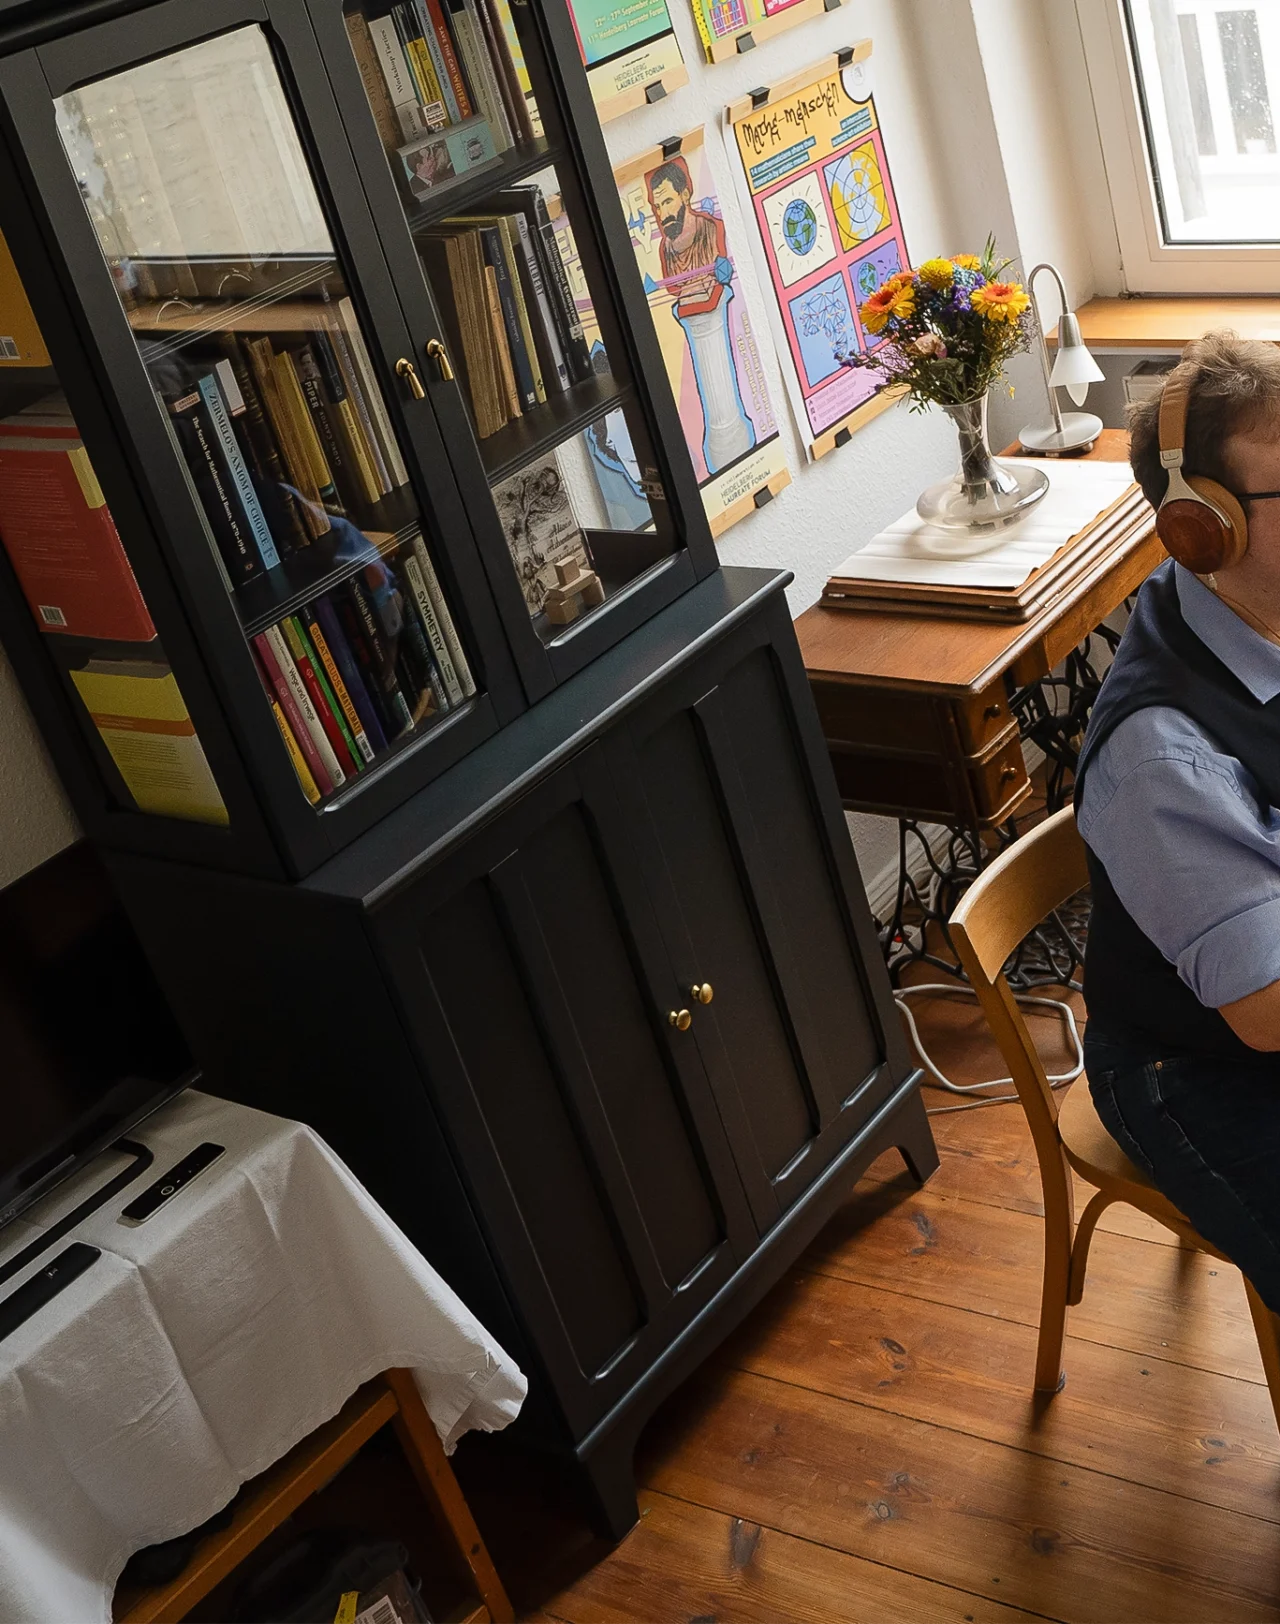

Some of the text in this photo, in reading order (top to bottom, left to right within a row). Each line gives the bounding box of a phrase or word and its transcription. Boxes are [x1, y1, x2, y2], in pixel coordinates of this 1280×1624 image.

[380, 29, 403, 94] Workshop Tactics
[420, 6, 433, 36] CREATING
[429, 37, 444, 74] CHARACTER
[438, 25, 447, 43] SAVE
[444, 44, 452, 57] THE
[448, 58, 457, 74] CAT!
[453, 74, 467, 107] WRITES
[613, 62, 647, 82] HEIDELBERG
[616, 64, 665, 91] LAUREATE FORUM
[518, 220, 544, 297] REID HILBERT
[548, 236, 569, 284] Mathematical
[741, 312, 753, 337] Forum
[304, 381, 319, 408] PIPER
[755, 372, 774, 415] Heidelberg
[192, 416, 200, 429] The
[197, 429, 208, 451] Search
[204, 450, 212, 460] for
[209, 460, 227, 502] Mathematical
[223, 501, 232, 521] Roots,
[209, 392, 236, 453] ZERMELO'S
[231, 456, 249, 491] AXIOM
[244, 491, 256, 505] OF
[250, 507, 269, 546] CHOICE
[720, 472, 754, 499] HEIDELBERG
[723, 469, 771, 506] LAUREATE FORUM
[354, 583, 368, 615] Scottish
[364, 613, 377, 636] Book
[416, 590, 445, 651] SYMMETRY
[312, 627, 329, 657] GREAT
[325, 657, 342, 688] FEUDS
[288, 667, 300, 687] Wege
[296, 686, 306, 700] und
[302, 697, 315, 722] Irrwege
